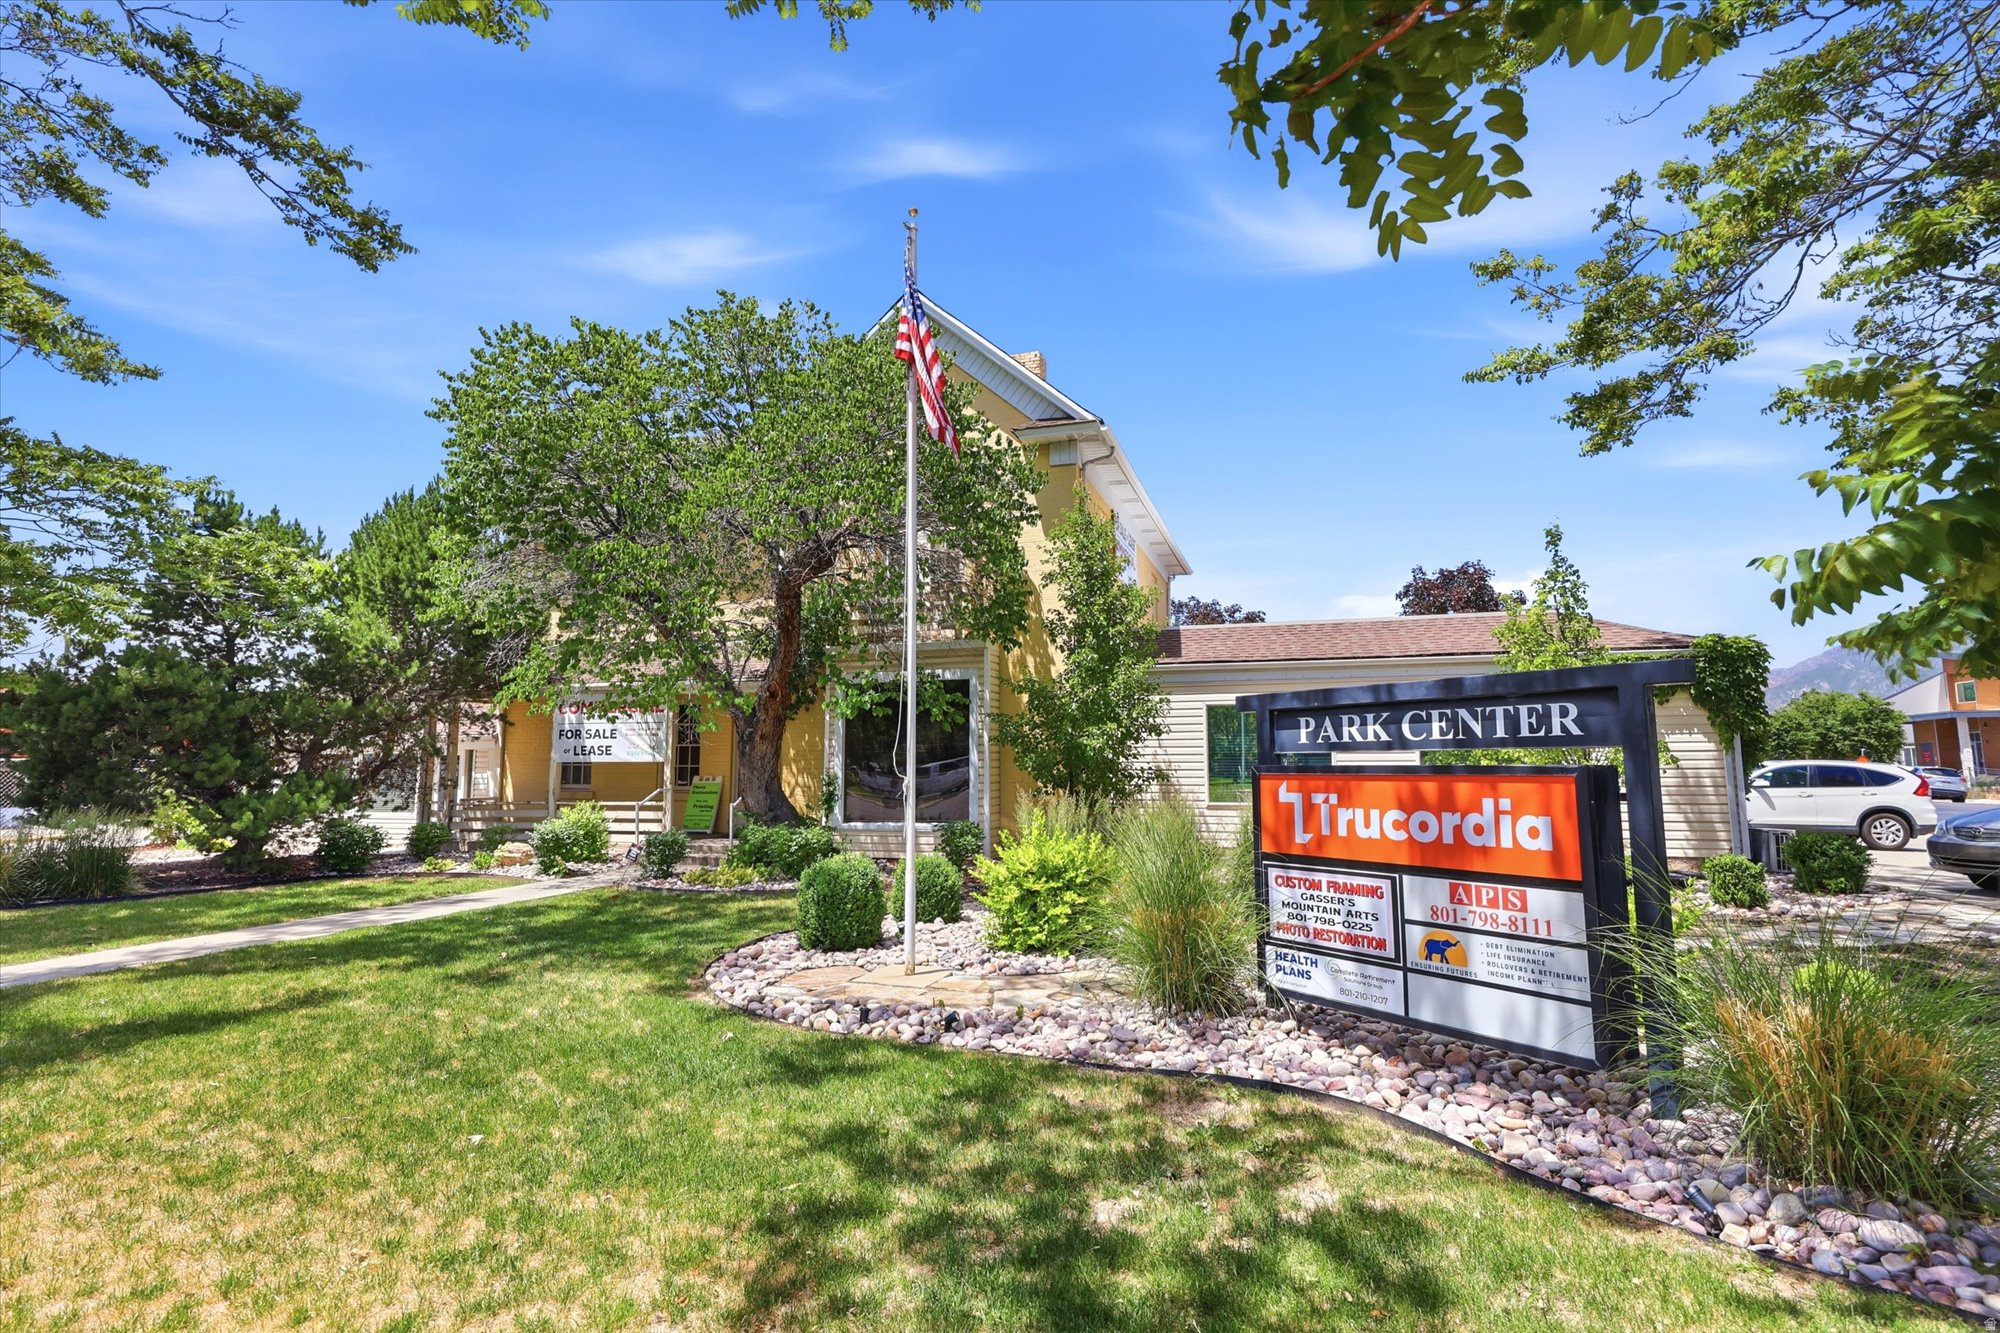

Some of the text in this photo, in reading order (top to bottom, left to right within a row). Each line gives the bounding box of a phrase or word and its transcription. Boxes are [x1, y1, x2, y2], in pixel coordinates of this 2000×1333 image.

[1297, 702, 1584, 744] PARK CENTER
[559, 729, 582, 740] FOR
[585, 729, 617, 740] SALE
[574, 745, 612, 756] LEASE
[1311, 792, 1553, 851] Trucordia
[1274, 874, 1384, 899] CUSTOM FRAMING
[1301, 892, 1355, 907] GASSER'S
[1453, 885, 1522, 911] APS
[1282, 901, 1379, 921] MOUNTAIN ARTS
[1287, 912, 1373, 932] 801-798-0225
[1430, 905, 1553, 937] 801-798-8111
[1276, 921, 1387, 952] PHOTO RESTORATION
[1486, 942, 1555, 958] DEBT ELIMINATION
[1275, 951, 1318, 968] HEALTH
[1504, 954, 1546, 966] INSURANCE
[1275, 964, 1312, 980] PLANS
[1330, 967, 1396, 985] Complete Retirement
[1411, 961, 1478, 978] ENSURING FUTURES
[1487, 961, 1528, 973] ROLLOVERS
[1538, 969, 1588, 983] RETIREMENT
[1488, 970, 1555, 987] INCOME PLANN
[1367, 981, 1383, 990] Group
[1340, 987, 1388, 1005] 801-210-1207
